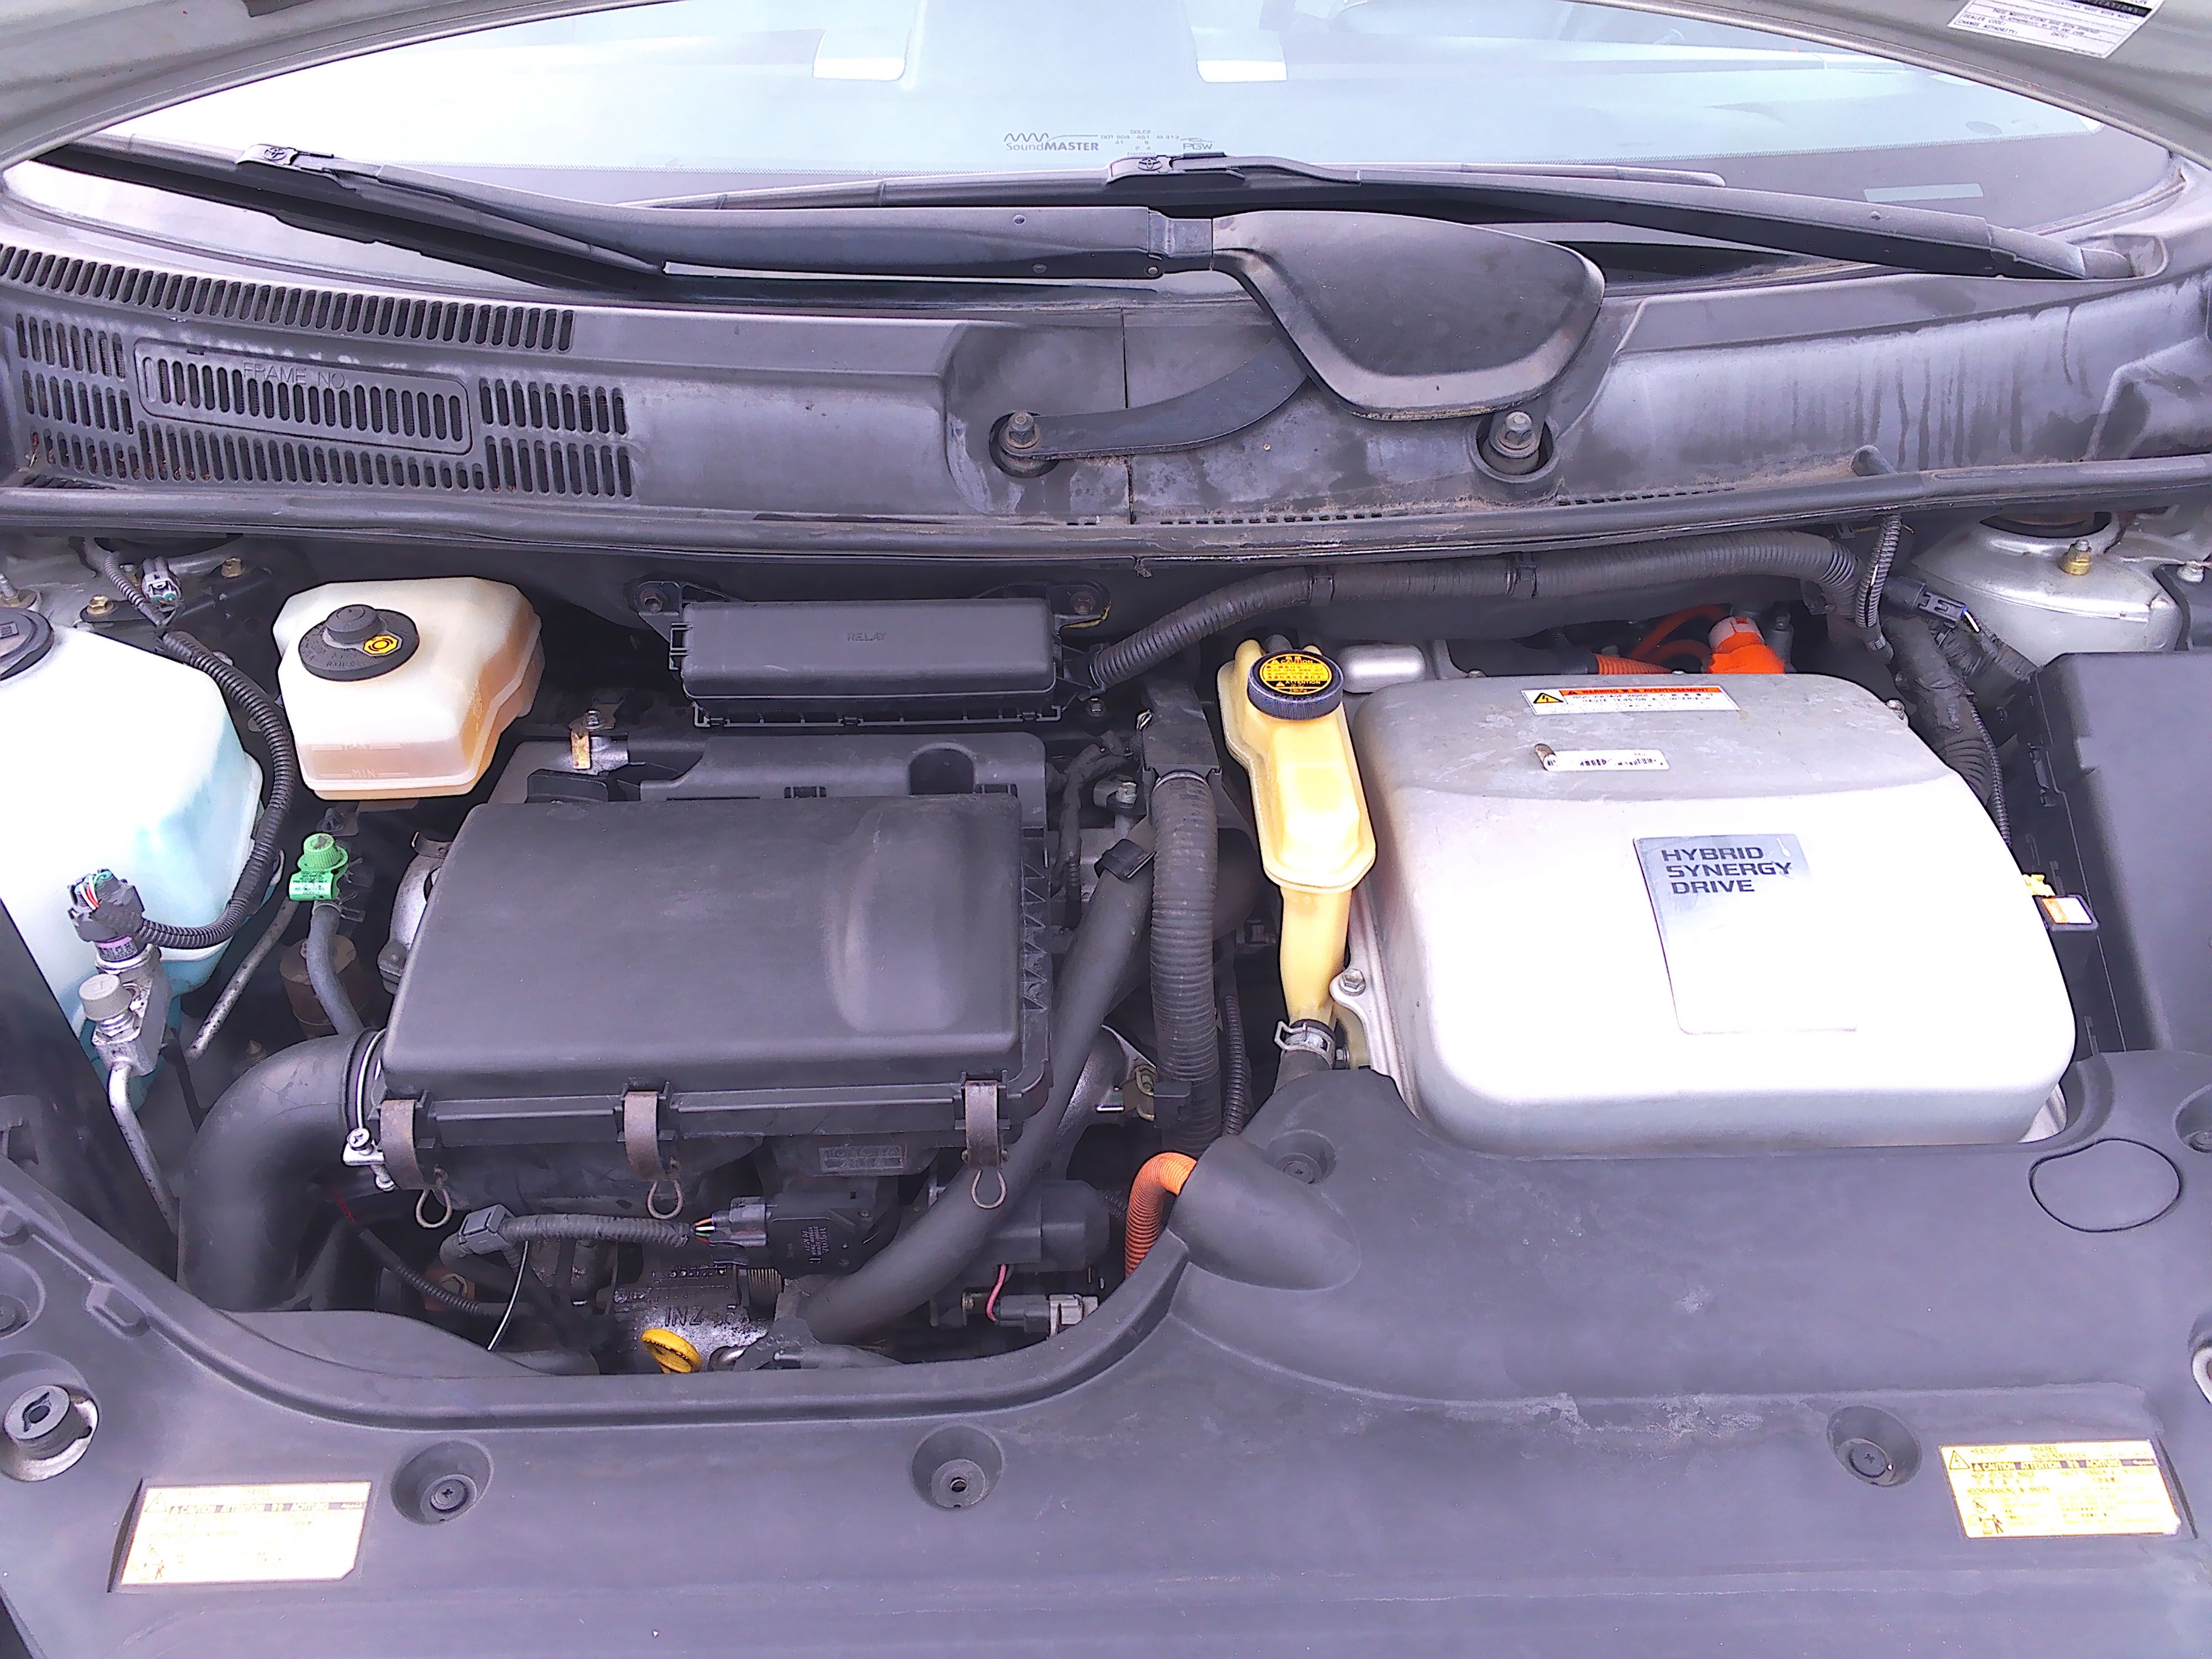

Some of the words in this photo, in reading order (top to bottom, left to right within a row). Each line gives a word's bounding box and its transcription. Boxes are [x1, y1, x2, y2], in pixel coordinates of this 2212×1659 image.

[1006, 142, 1099, 151] SoundMASTER
[244, 362, 307, 385] FRAME
[847, 632, 886, 641] RELAY
[1661, 847, 1764, 861] HYBRID
[1666, 862, 1791, 878] SYNERGY
[1671, 879, 1755, 894] DRIVE
